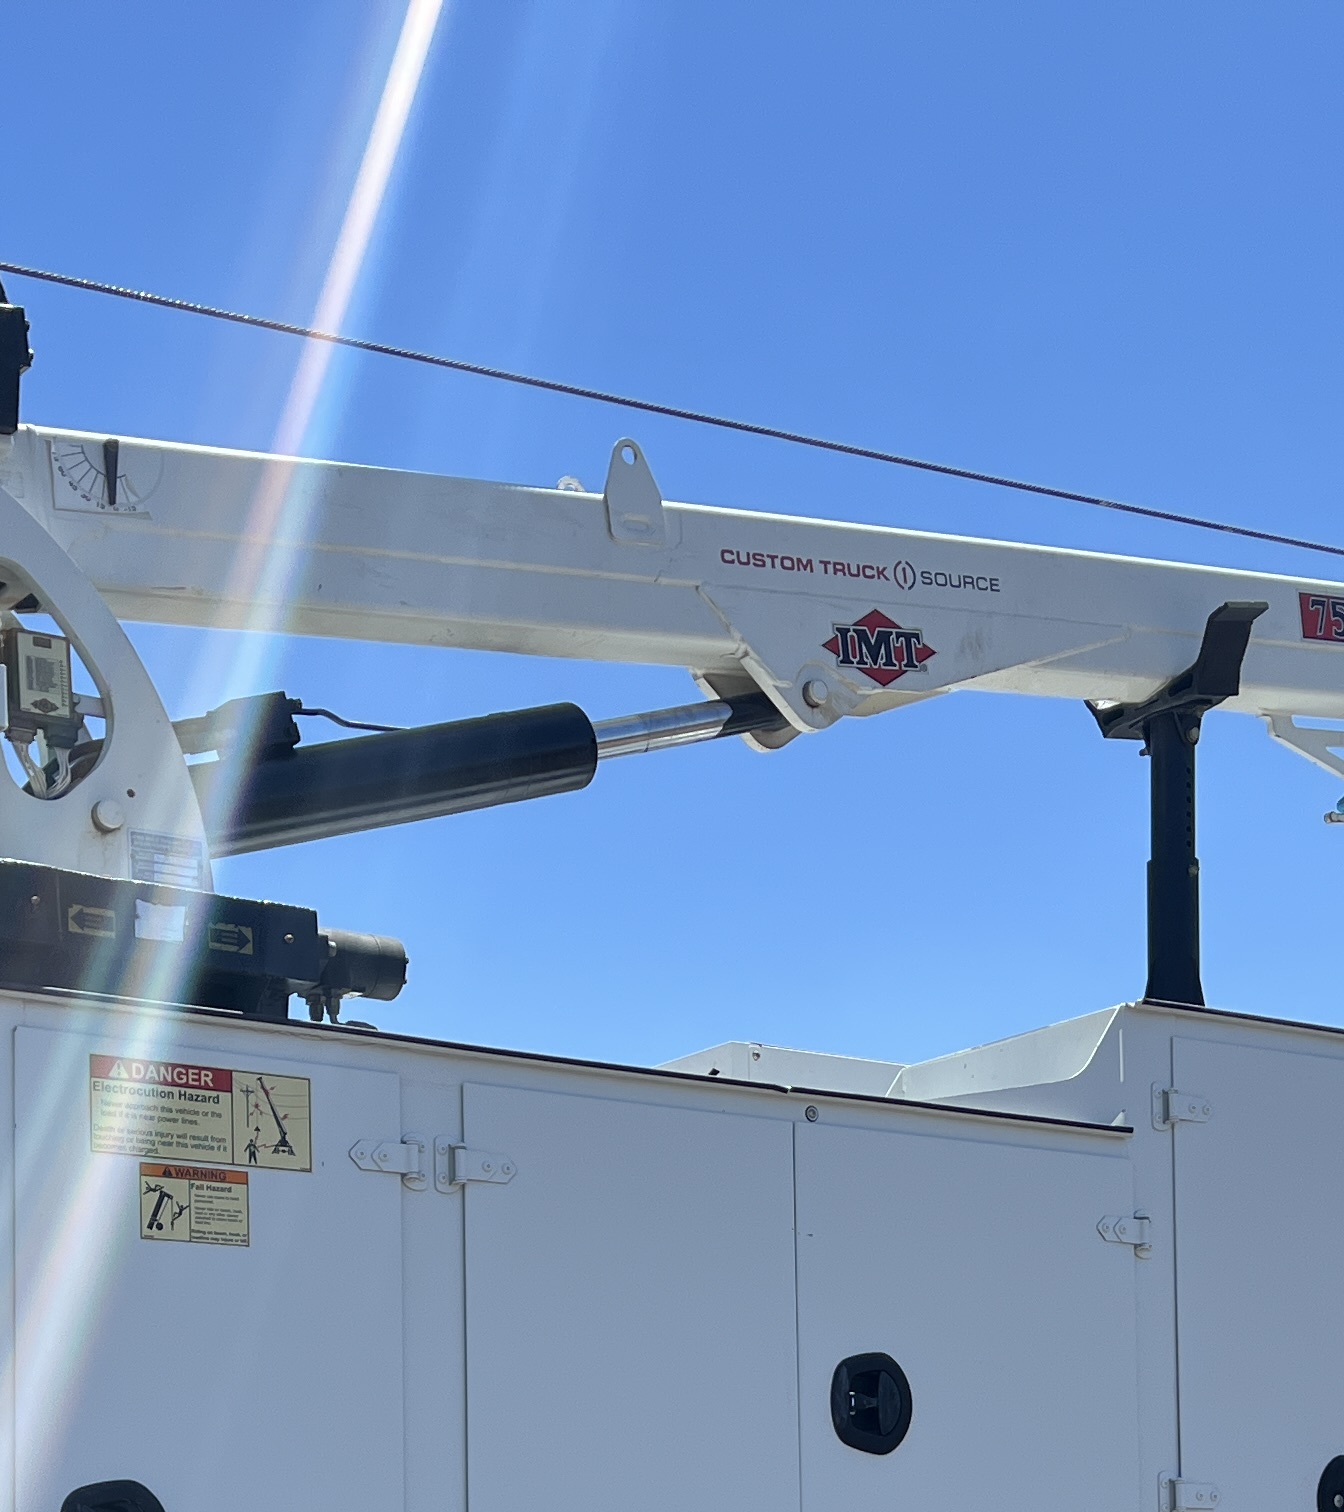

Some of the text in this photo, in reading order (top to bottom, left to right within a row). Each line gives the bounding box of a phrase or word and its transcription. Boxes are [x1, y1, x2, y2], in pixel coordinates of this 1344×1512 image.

[720, 548, 814, 574] CUSTOM
[819, 559, 890, 581] TRUCK
[920, 570, 1001, 593] SOURCE
[834, 625, 922, 671] IMT
[131, 1063, 214, 1087] DANGER
[92, 1080, 220, 1105] Electrocution Hazard
[160, 1105, 173, 1114] this
[175, 1107, 200, 1117] vehicle
[211, 1109, 223, 1119] the
[158, 1115, 179, 1125] power
[155, 1128, 174, 1140] injury
[176, 1131, 188, 1140] will
[189, 1132, 209, 1142] result
[211, 1134, 227, 1144] from
[176, 1140, 189, 1149] this
[190, 1142, 215, 1151] vehicle
[174, 1167, 227, 1181] WARNING
[190, 1182, 233, 1193] Fall Hazard
